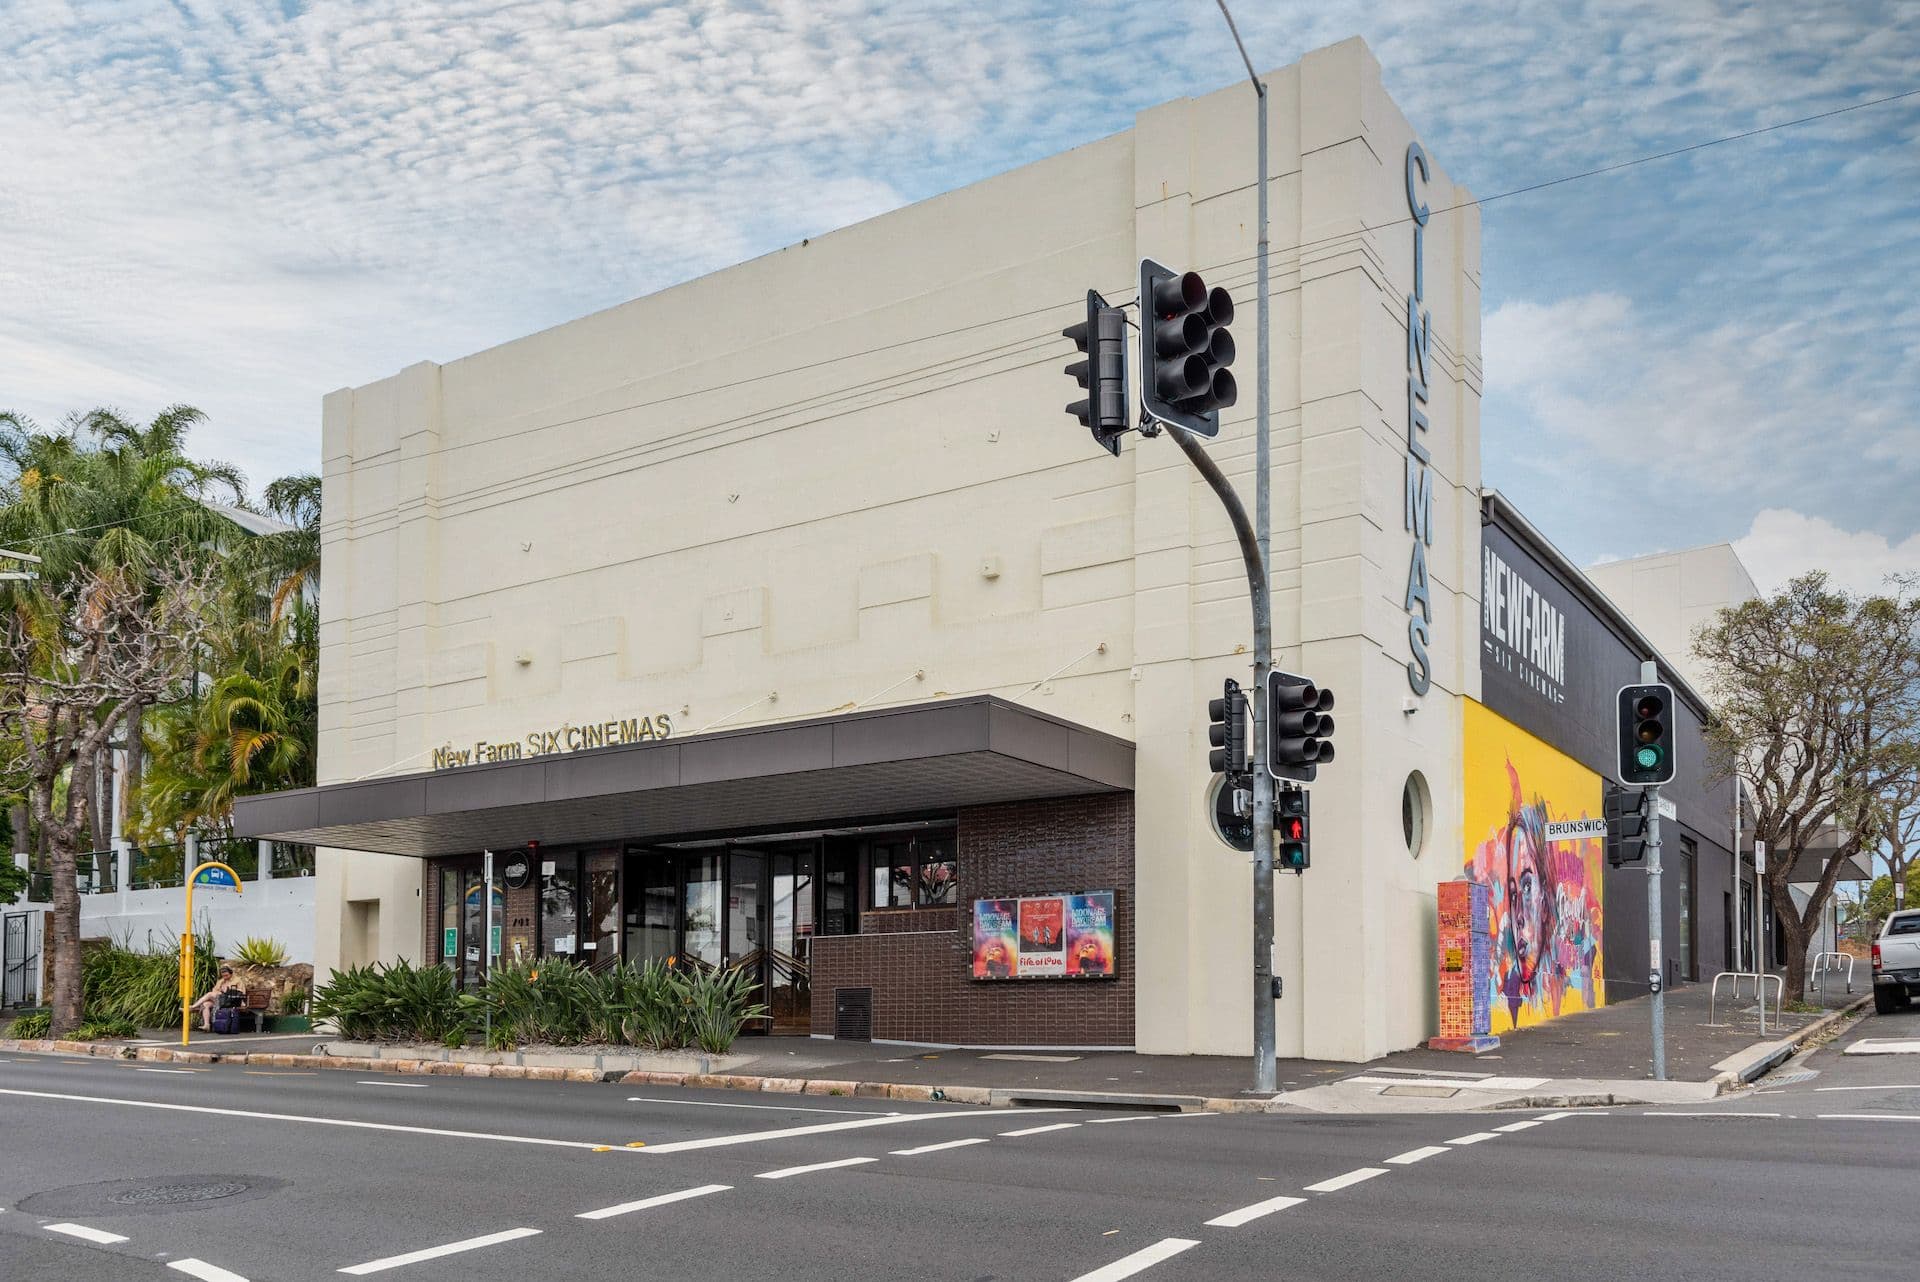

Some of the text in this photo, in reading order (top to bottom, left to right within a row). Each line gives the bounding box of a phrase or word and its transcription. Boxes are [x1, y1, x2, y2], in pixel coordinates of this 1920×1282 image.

[1406, 140, 1432, 697] CINEMAS
[1495, 646, 1512, 672] SIX
[432, 714, 671, 770] New Farm SIX CINEMAS
